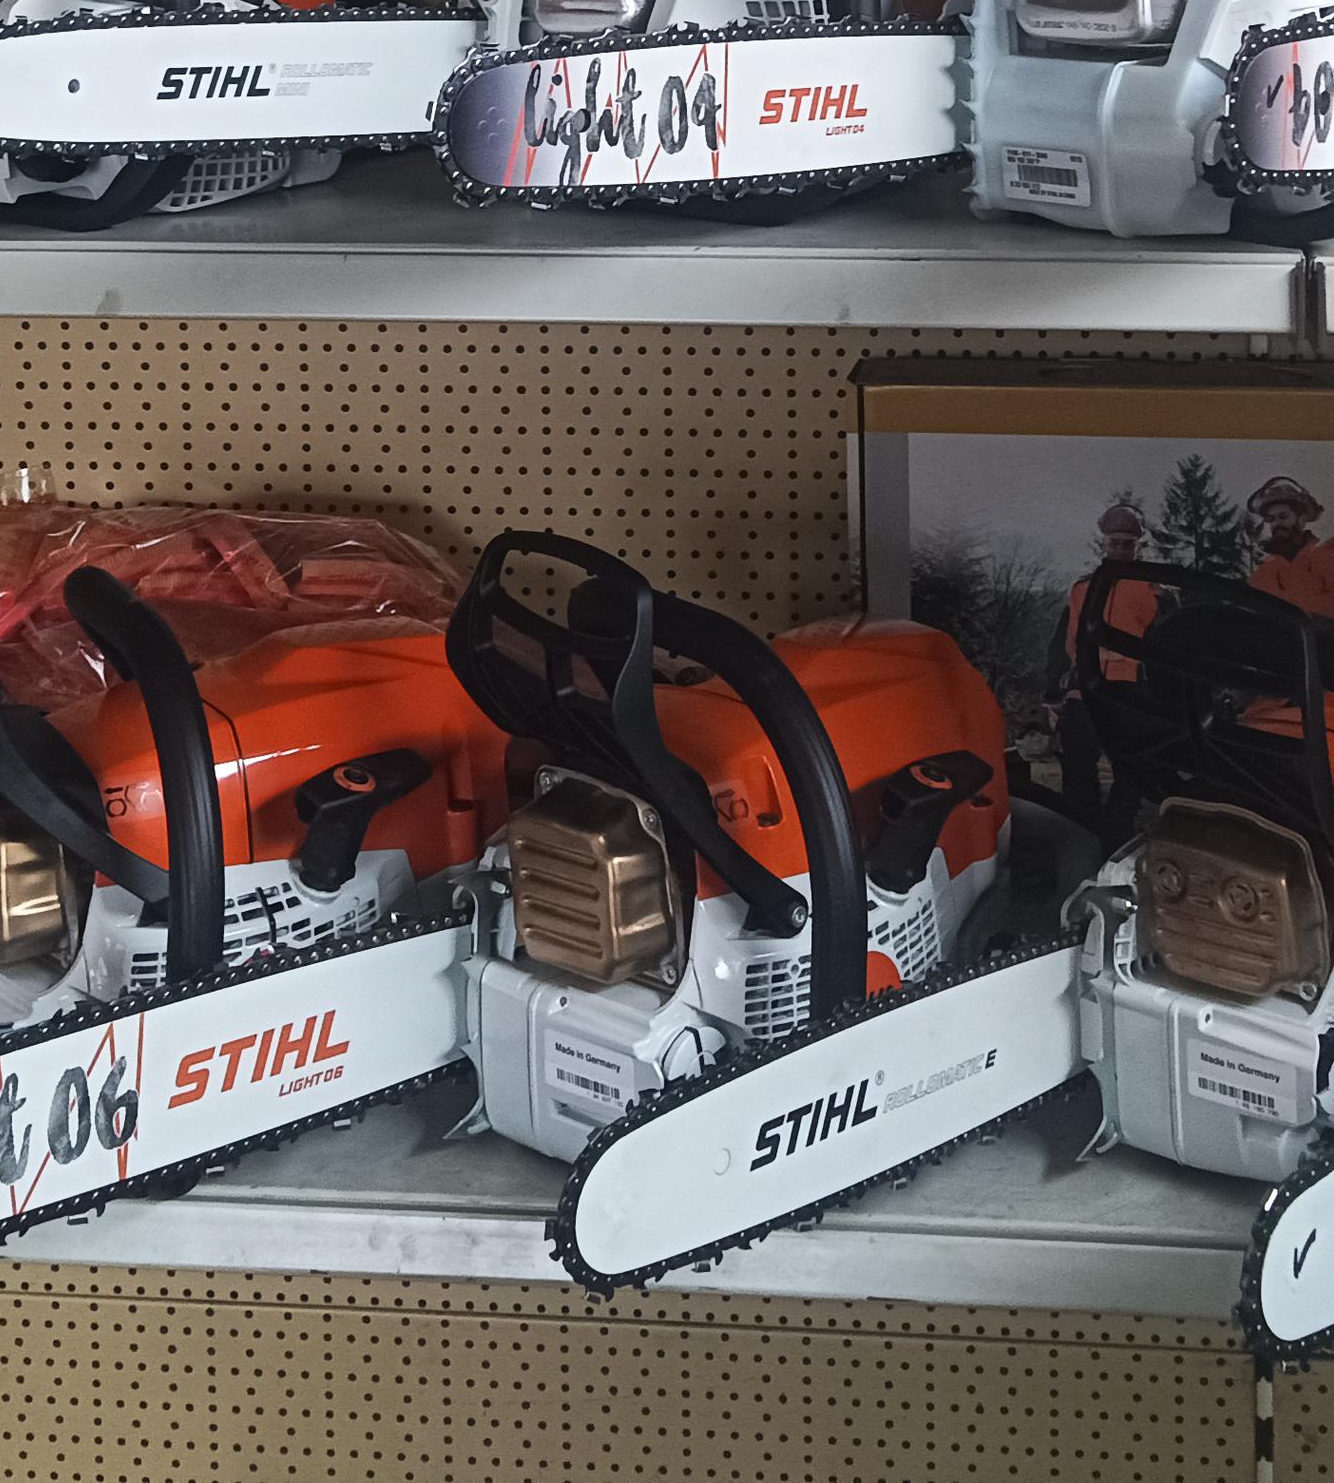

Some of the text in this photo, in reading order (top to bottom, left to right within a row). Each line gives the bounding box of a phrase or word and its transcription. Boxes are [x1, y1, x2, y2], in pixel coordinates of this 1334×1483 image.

[156, 65, 271, 100] STIHL
[759, 83, 868, 125] STIHL
[167, 1009, 351, 1110] STIHL
[555, 1041, 621, 1074] Made in Germany
[1200, 1051, 1280, 1084] Made in Germany
[750, 1048, 997, 1172] STIHL ROLLOMATIC E
